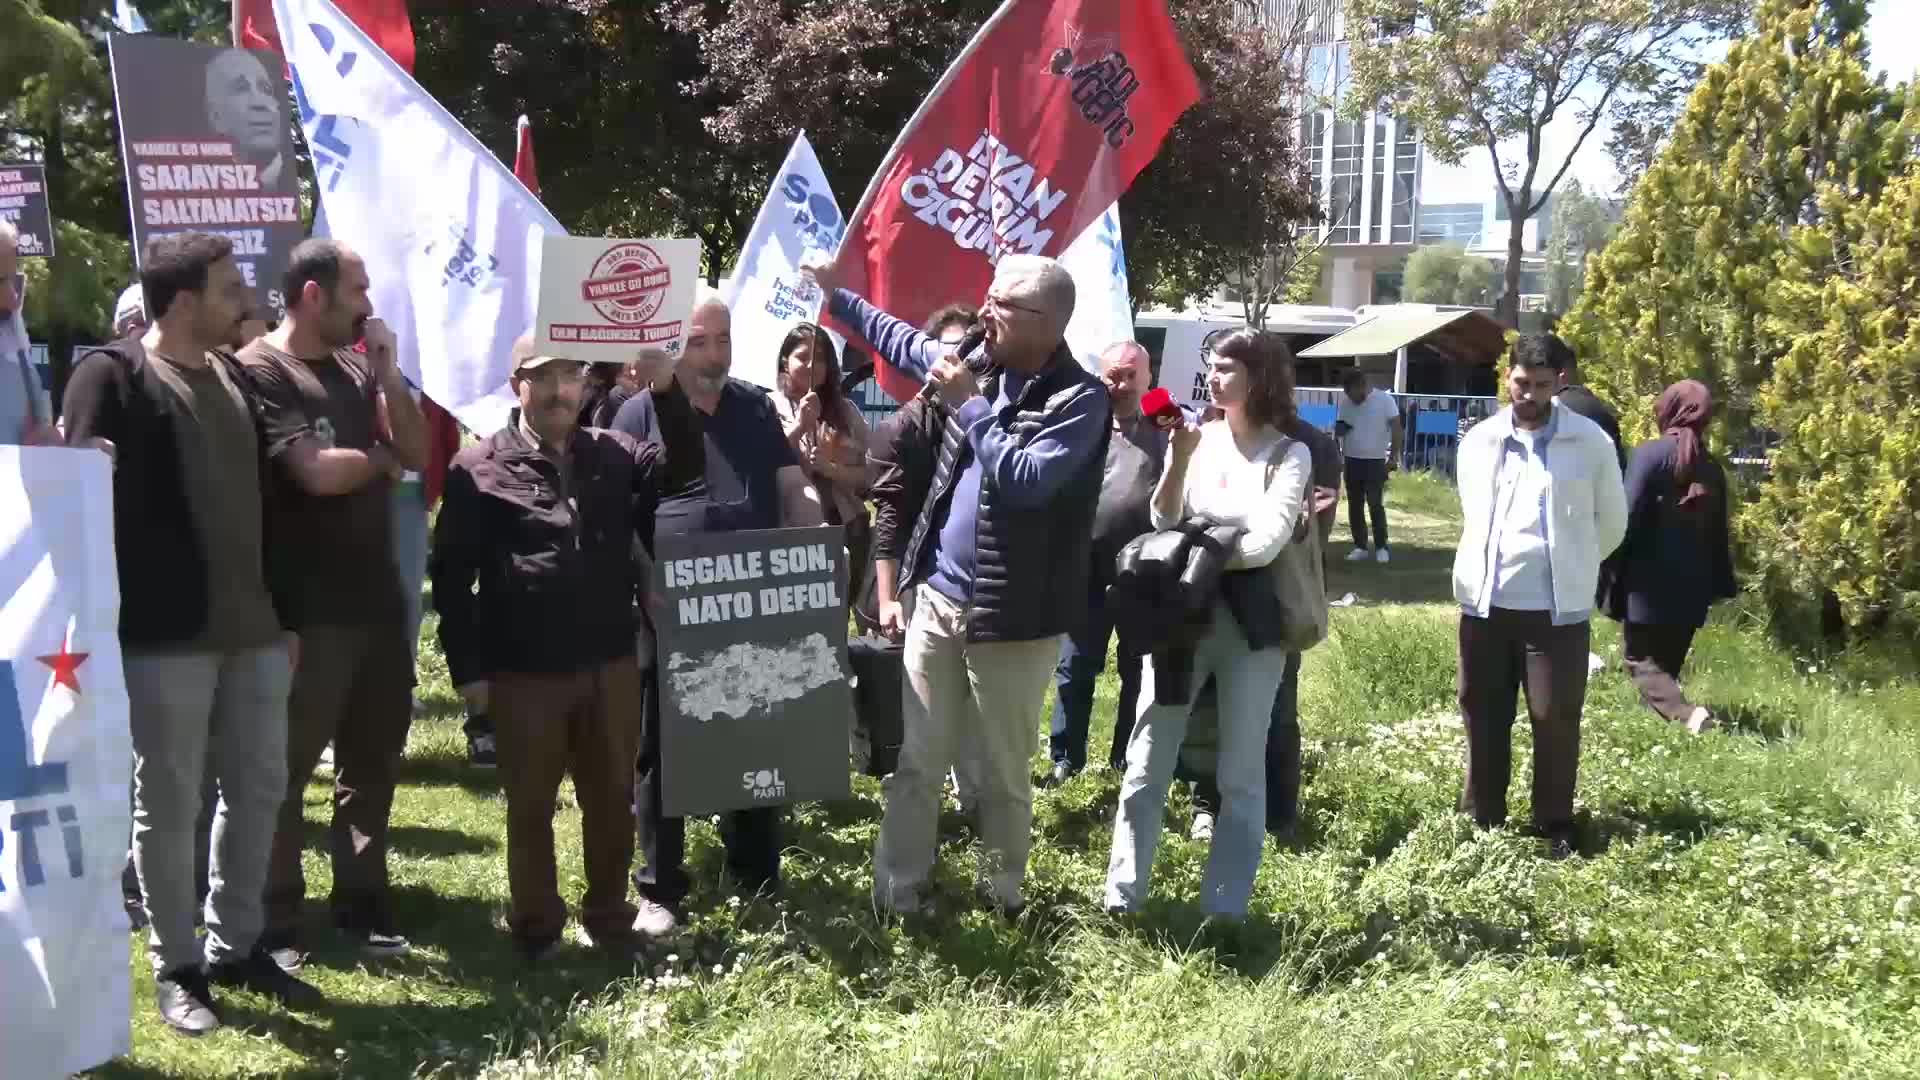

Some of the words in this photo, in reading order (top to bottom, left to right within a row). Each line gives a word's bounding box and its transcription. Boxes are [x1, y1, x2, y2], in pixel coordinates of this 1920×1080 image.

[137, 164, 260, 191] SARAYSIZ
[143, 197, 297, 225] SALTANATSIZ
[769, 544, 835, 576] SON,
[679, 591, 753, 625] NATO
[760, 581, 841, 616] DEFOL
[743, 768, 785, 789] SOL
